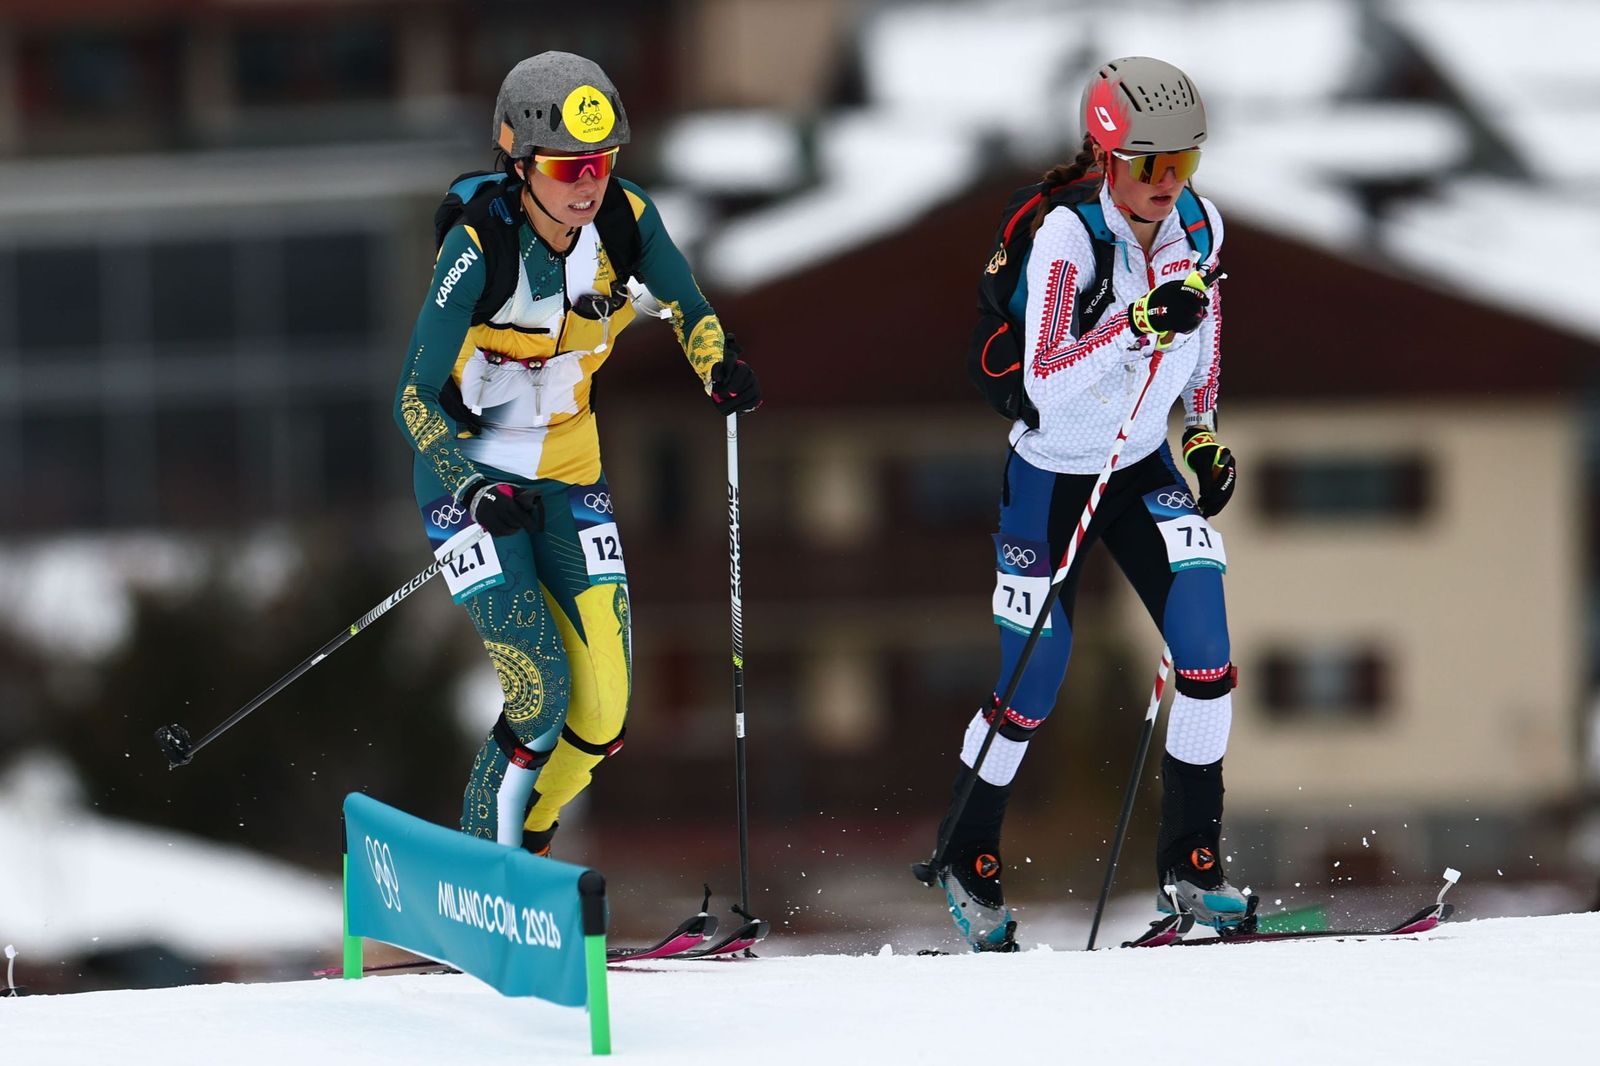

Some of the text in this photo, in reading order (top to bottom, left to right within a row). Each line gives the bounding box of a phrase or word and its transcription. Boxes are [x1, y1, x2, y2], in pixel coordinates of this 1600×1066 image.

[435, 246, 479, 309] KARBON
[1176, 526, 1213, 549] 7.1
[1003, 585, 1031, 616] 7.1
[438, 880, 484, 930] MILANO
[521, 907, 562, 950] 2026
